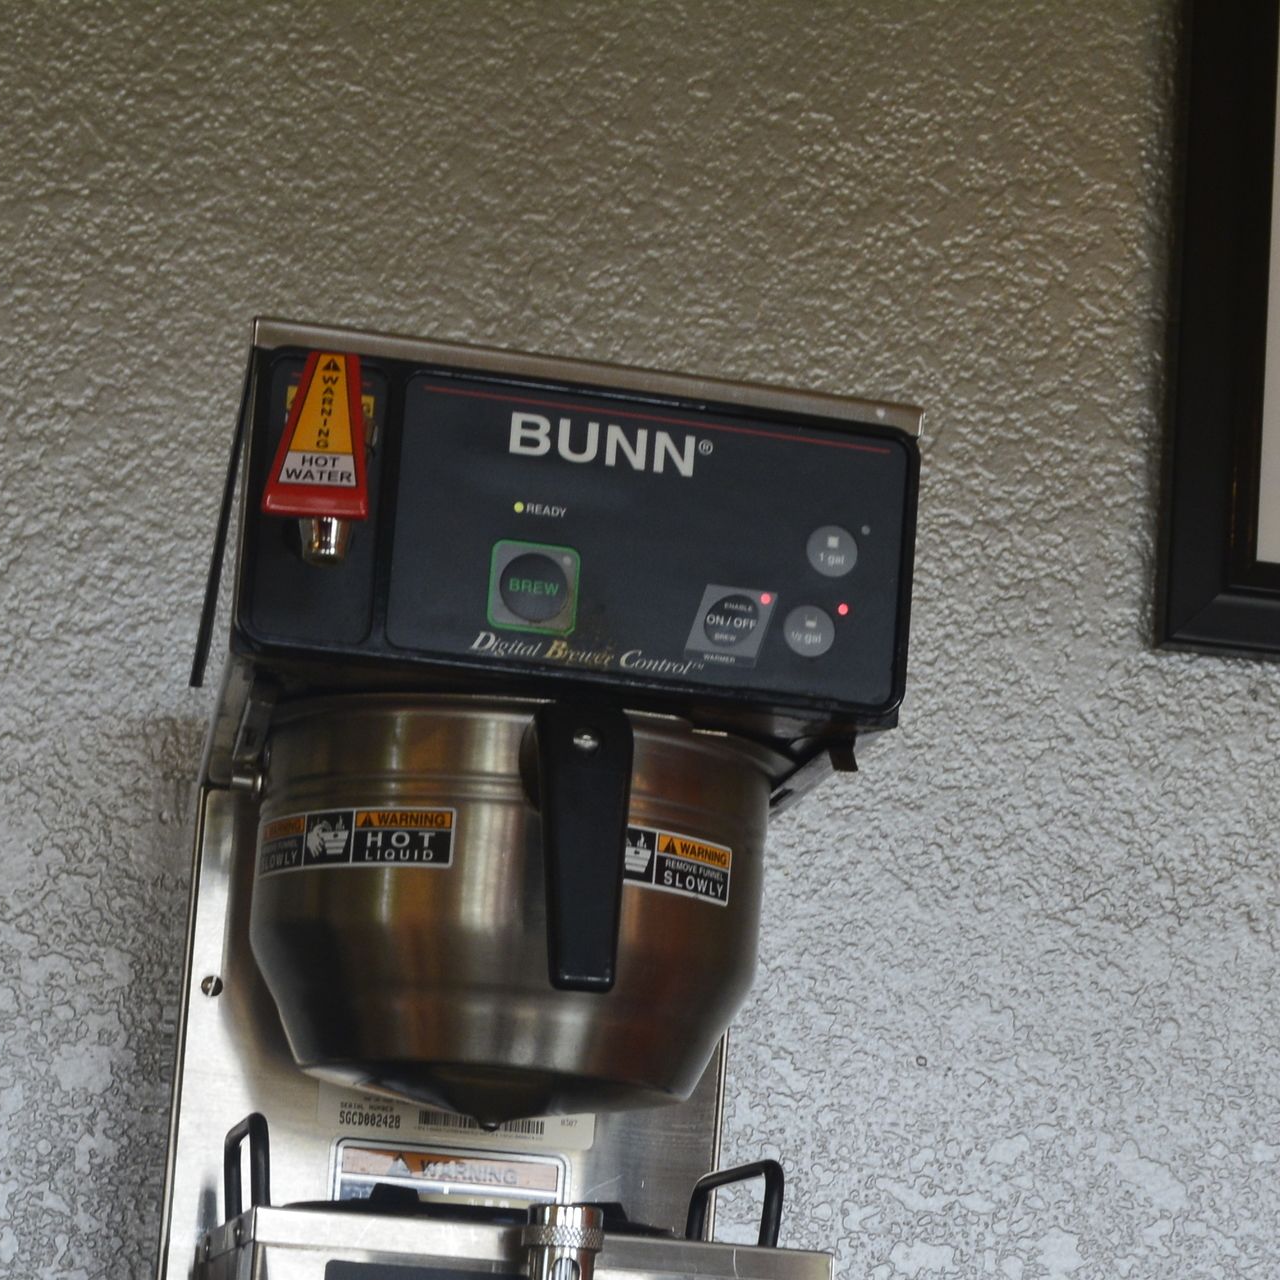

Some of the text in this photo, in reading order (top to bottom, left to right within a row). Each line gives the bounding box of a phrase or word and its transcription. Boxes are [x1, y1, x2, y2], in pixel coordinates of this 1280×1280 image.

[316, 375, 339, 449] WARNING
[509, 411, 696, 478] BUNN
[301, 454, 340, 469] HOT
[285, 467, 352, 483] WATER
[526, 502, 568, 518] READY
[508, 577, 560, 597] BREW
[706, 614, 725, 626] ON
[733, 617, 757, 630] OFF
[470, 631, 542, 658] Digital
[543, 639, 614, 667] Brewer
[377, 812, 446, 827] WARNING
[366, 831, 436, 849] HOT
[365, 848, 434, 861] LIQUID
[680, 842, 727, 866] WARNING
[665, 858, 724, 881] REMOVE FUNNEL
[663, 870, 725, 898] SLOWLY
[420, 1159, 518, 1185] WARNING
